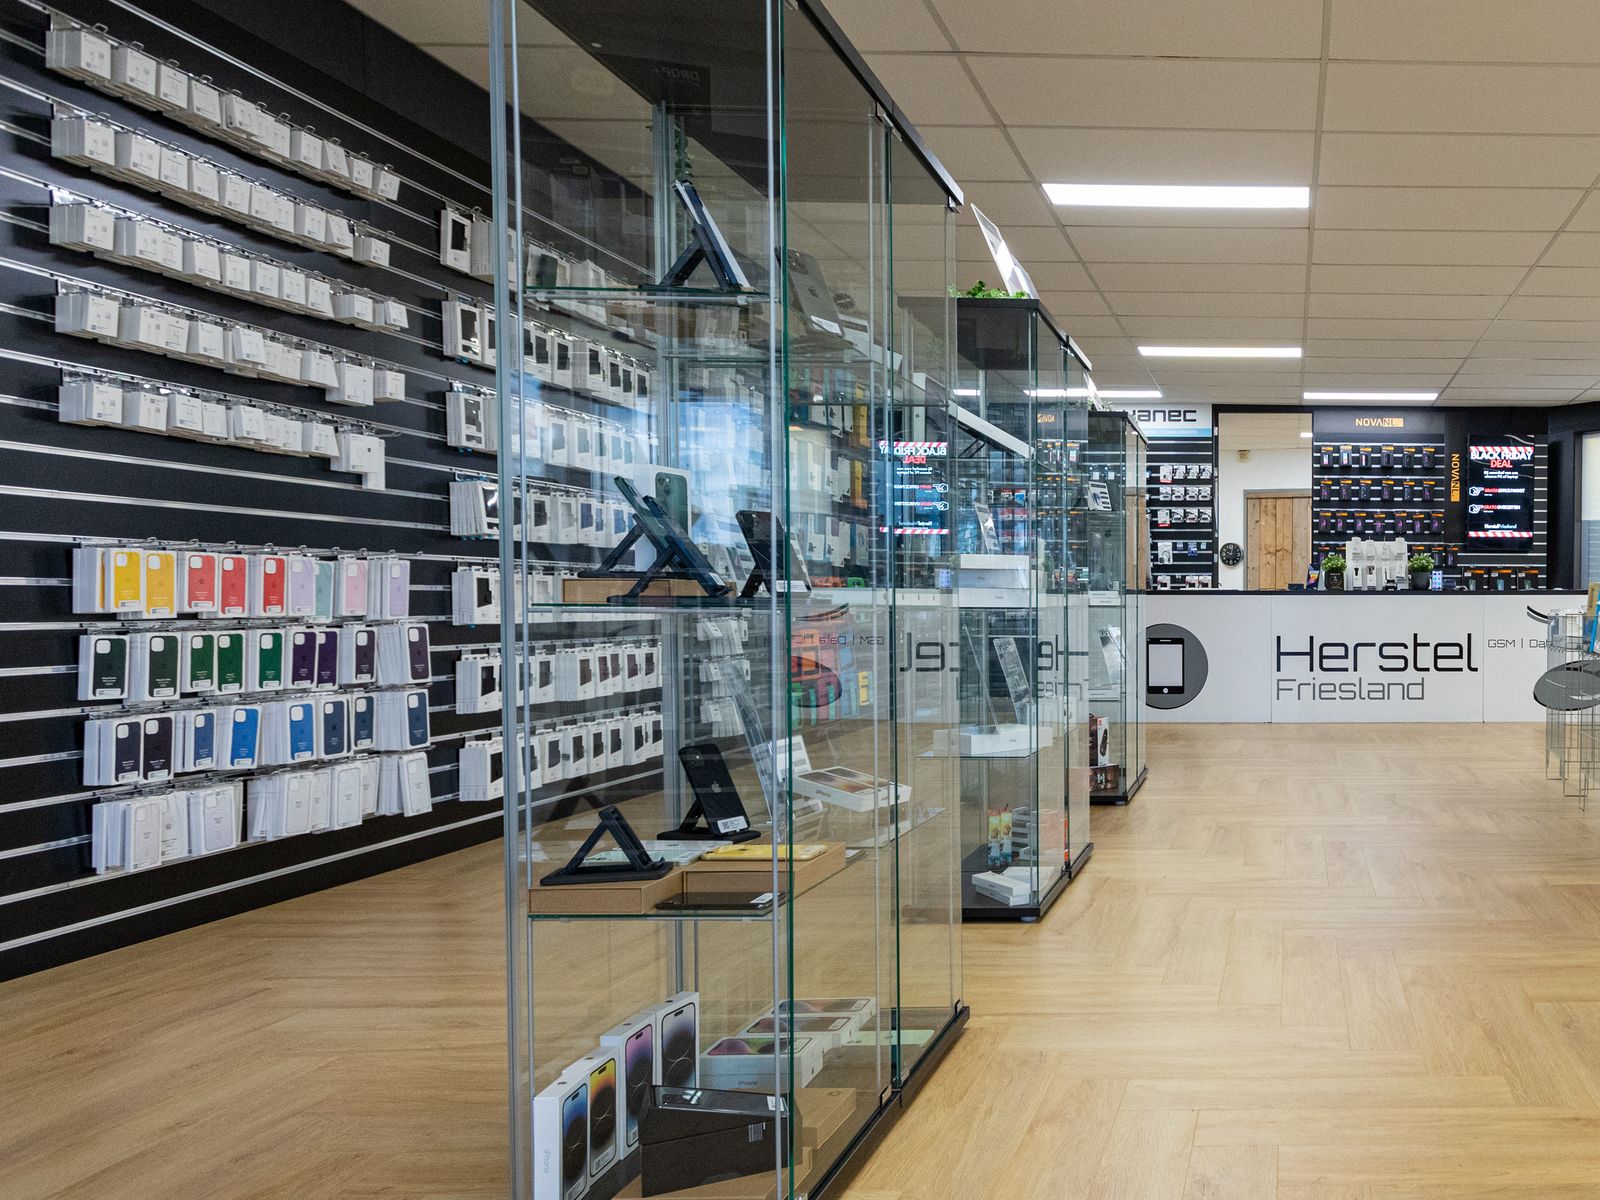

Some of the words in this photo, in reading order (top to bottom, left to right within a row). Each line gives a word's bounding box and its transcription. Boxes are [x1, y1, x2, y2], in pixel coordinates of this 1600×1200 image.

[1470, 450, 1501, 460] BLACK
[1501, 450, 1533, 460] FRIDAY
[1490, 459, 1513, 468] DEAL
[1487, 638, 1516, 649] GSM
[1276, 633, 1479, 673] Herstel
[1276, 676, 1425, 701] Friesland
